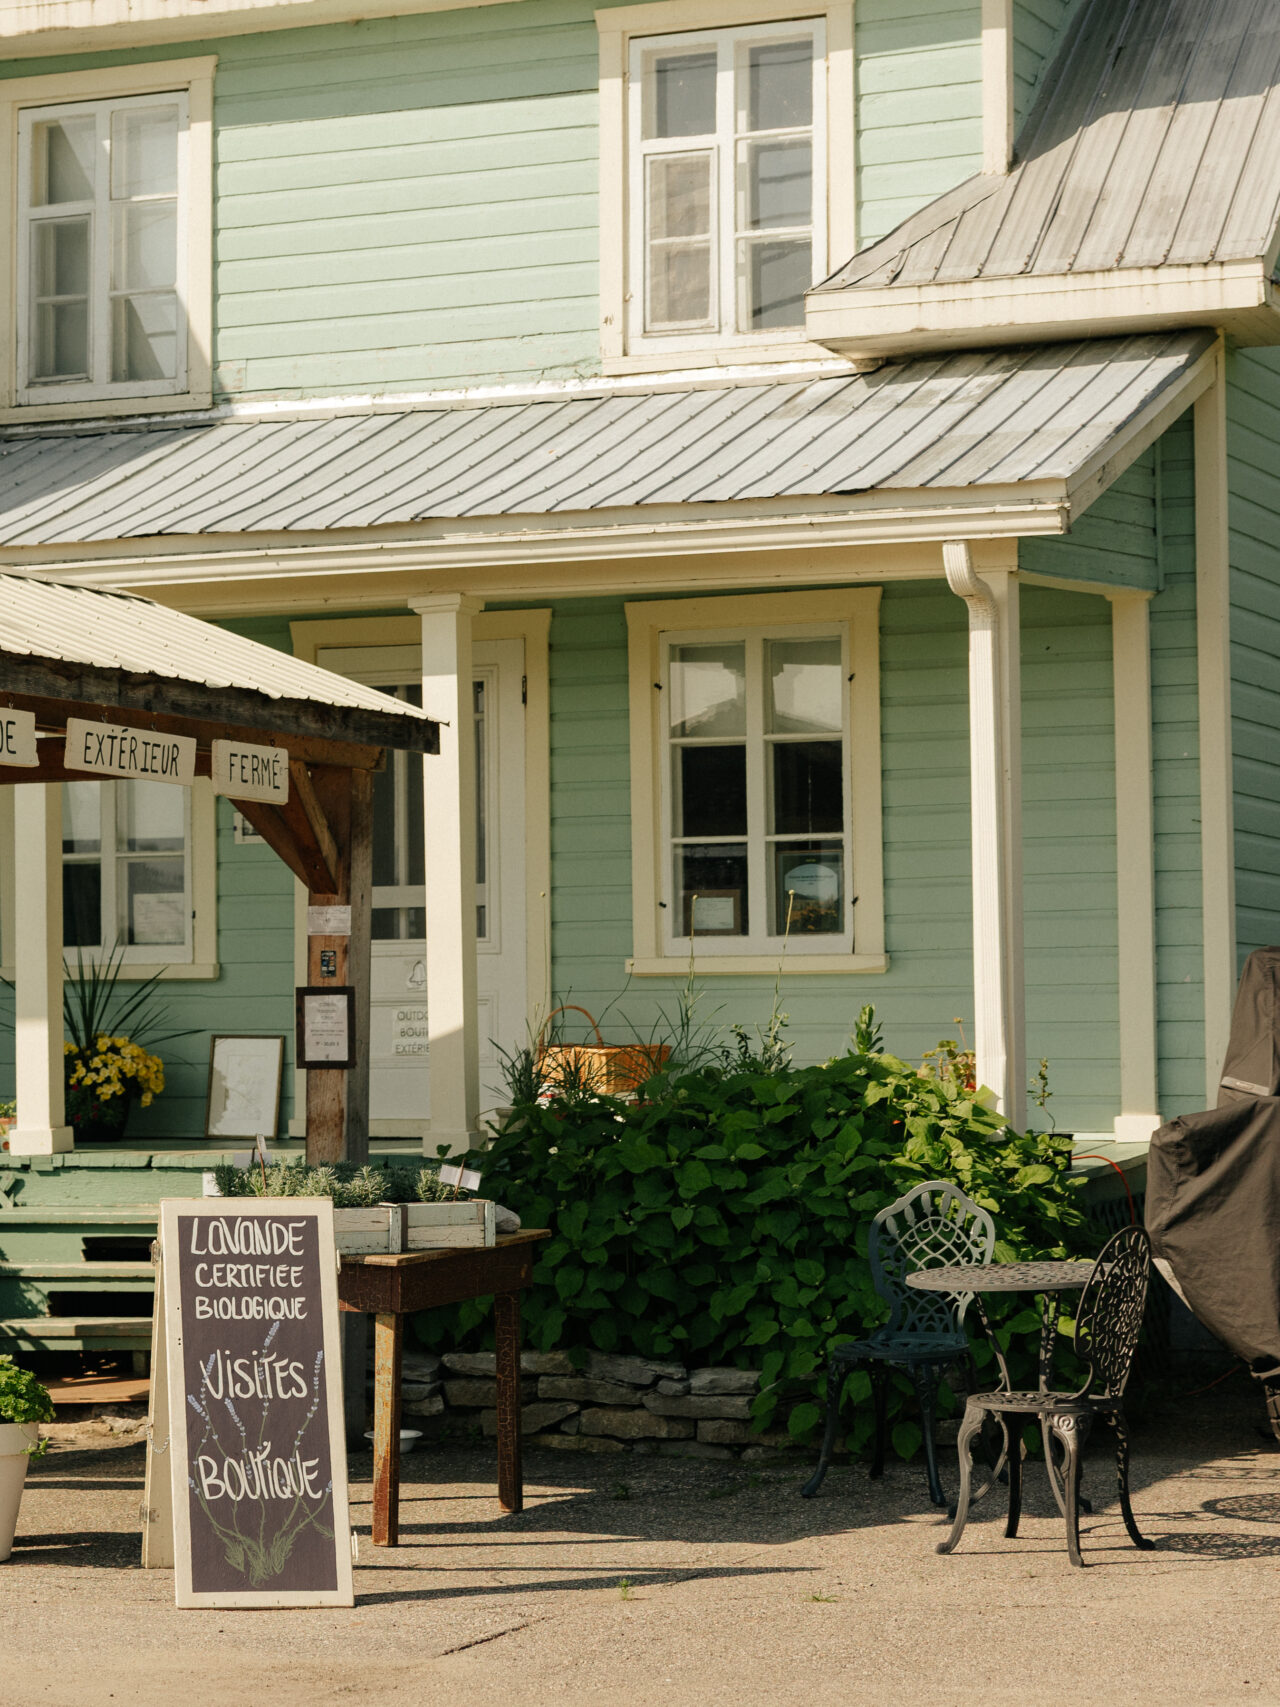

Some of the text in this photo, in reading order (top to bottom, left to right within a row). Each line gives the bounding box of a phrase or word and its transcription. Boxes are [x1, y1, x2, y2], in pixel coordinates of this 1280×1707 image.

[83, 728, 180, 777] EXTÉRIEUR
[229, 753, 281, 790] FERMÉ
[397, 1011, 429, 1022] OUTDO
[400, 1026, 429, 1038] BOUTI
[395, 1042, 430, 1055] EXTÉRIE
[195, 1296, 308, 1320] BIOLOGIQUE
